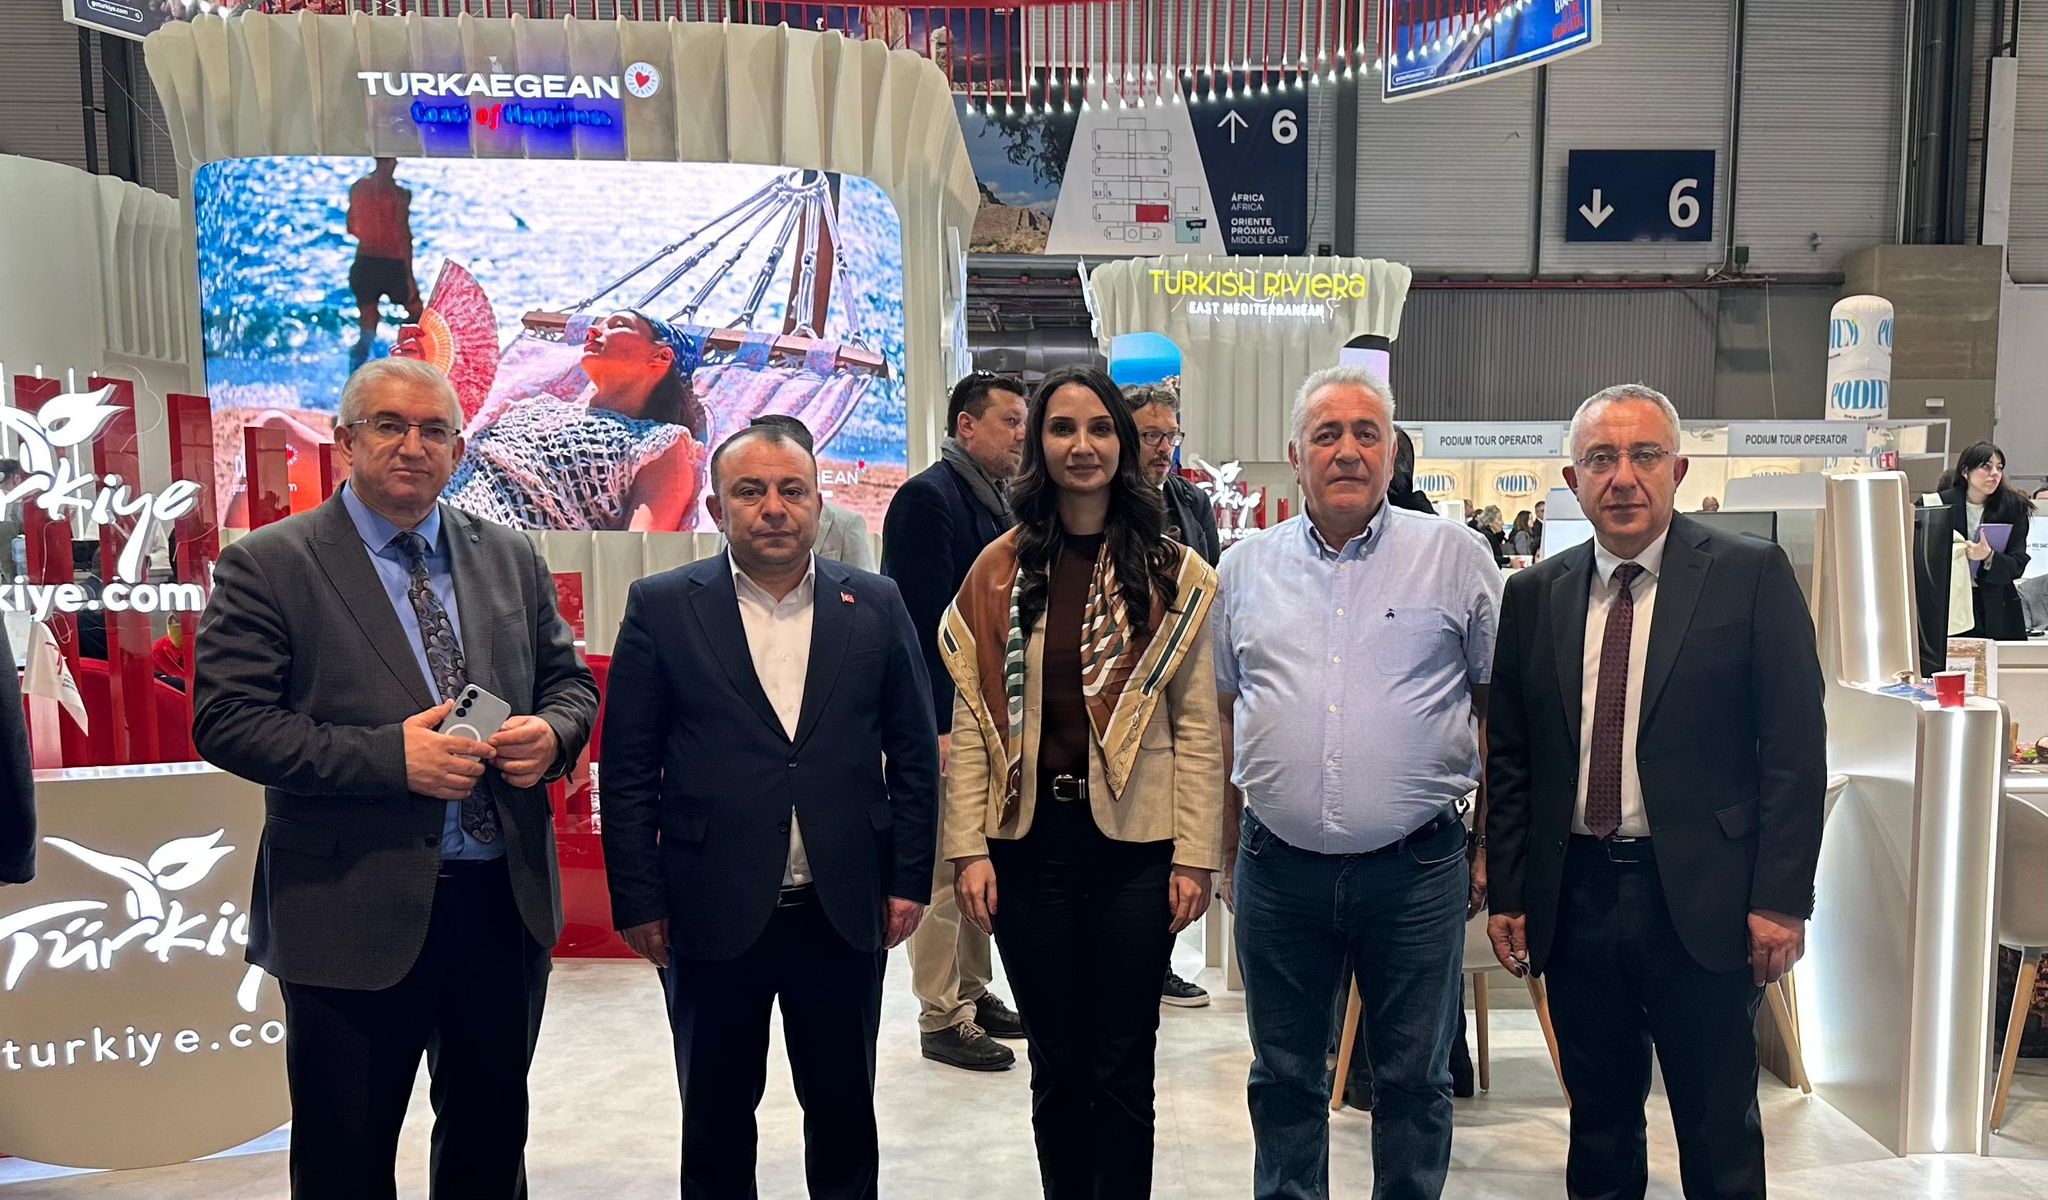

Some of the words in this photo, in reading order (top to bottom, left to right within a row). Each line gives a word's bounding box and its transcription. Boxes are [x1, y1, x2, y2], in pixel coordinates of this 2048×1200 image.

[357, 72, 621, 99] TURKAEGEAN
[476, 104, 503, 130] of
[1271, 109, 1299, 144] 6
[1231, 191, 1265, 202] ÁFRICA
[1668, 178, 1700, 228] 6
[1231, 203, 1263, 211] AFRICA
[1231, 217, 1272, 226] ORIENTE
[1231, 225, 1276, 235] PRÓXIMO
[1231, 236, 1265, 244] MIDDLE
[1267, 236, 1289, 244] EAST
[1148, 270, 1255, 297] TURKISH
[1188, 301, 1220, 315] EAST
[1223, 302, 1325, 317] MEDITERRANEAN
[1440, 436, 1472, 446] PODIUM
[1474, 435, 1497, 446] TOUR
[1498, 435, 1543, 446] OPERATOR
[1745, 434, 1777, 444] PODIUM
[1779, 434, 1802, 444] TOUR
[1803, 434, 1848, 444] OPERATOR
[0, 899, 264, 1012] Türkiy
[2, 1020, 285, 1070] turkiye.co
